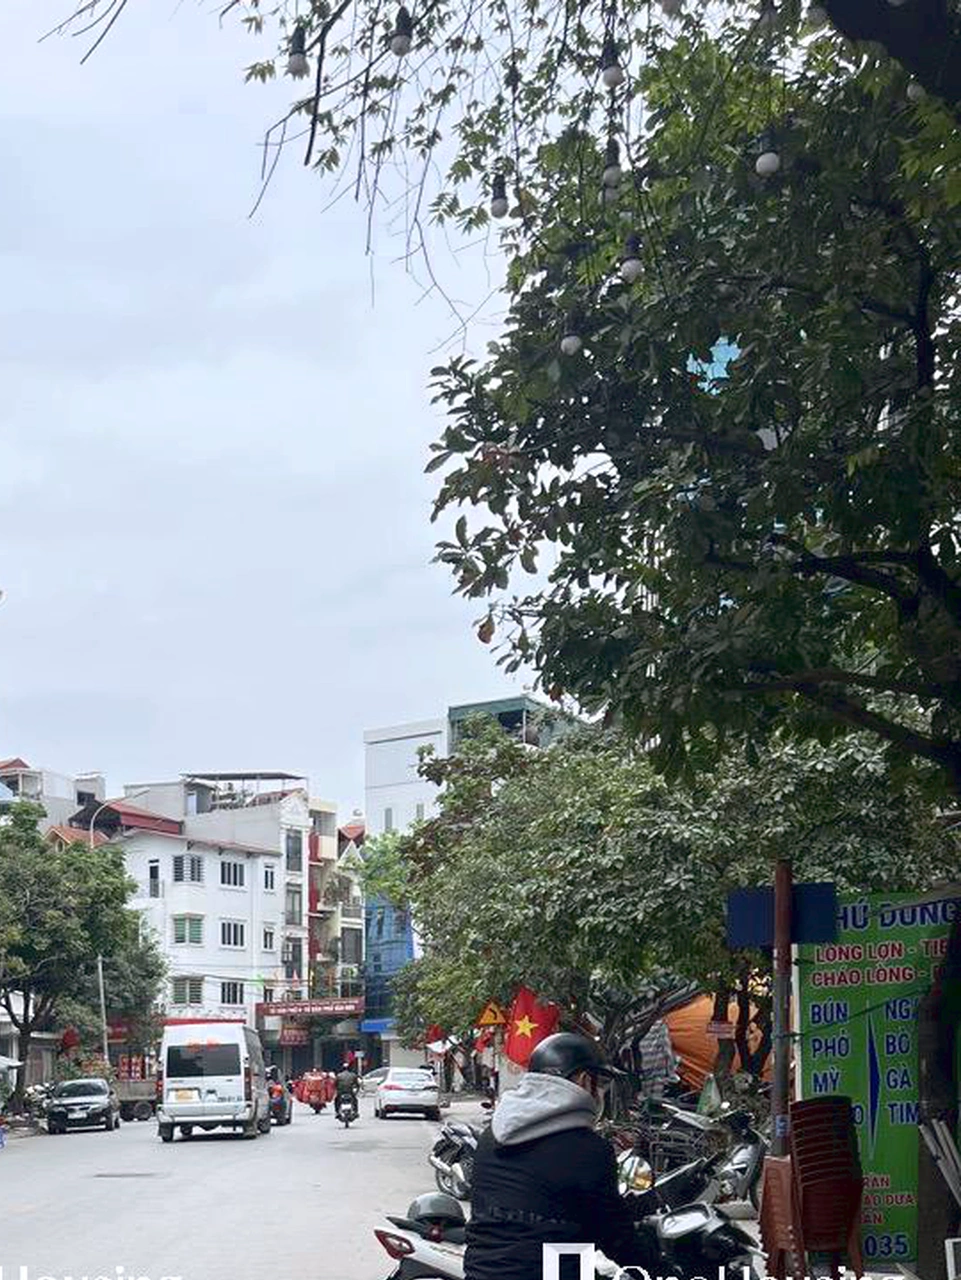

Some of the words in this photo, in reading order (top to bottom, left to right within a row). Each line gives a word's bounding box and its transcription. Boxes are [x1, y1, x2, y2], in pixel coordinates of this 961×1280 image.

[812, 964, 861, 987] CHÁO
[867, 963, 914, 985] LÒNG
[811, 997, 848, 1024] BÚN
[887, 1063, 912, 1088] GÀ
[864, 1235, 909, 1258] 035
